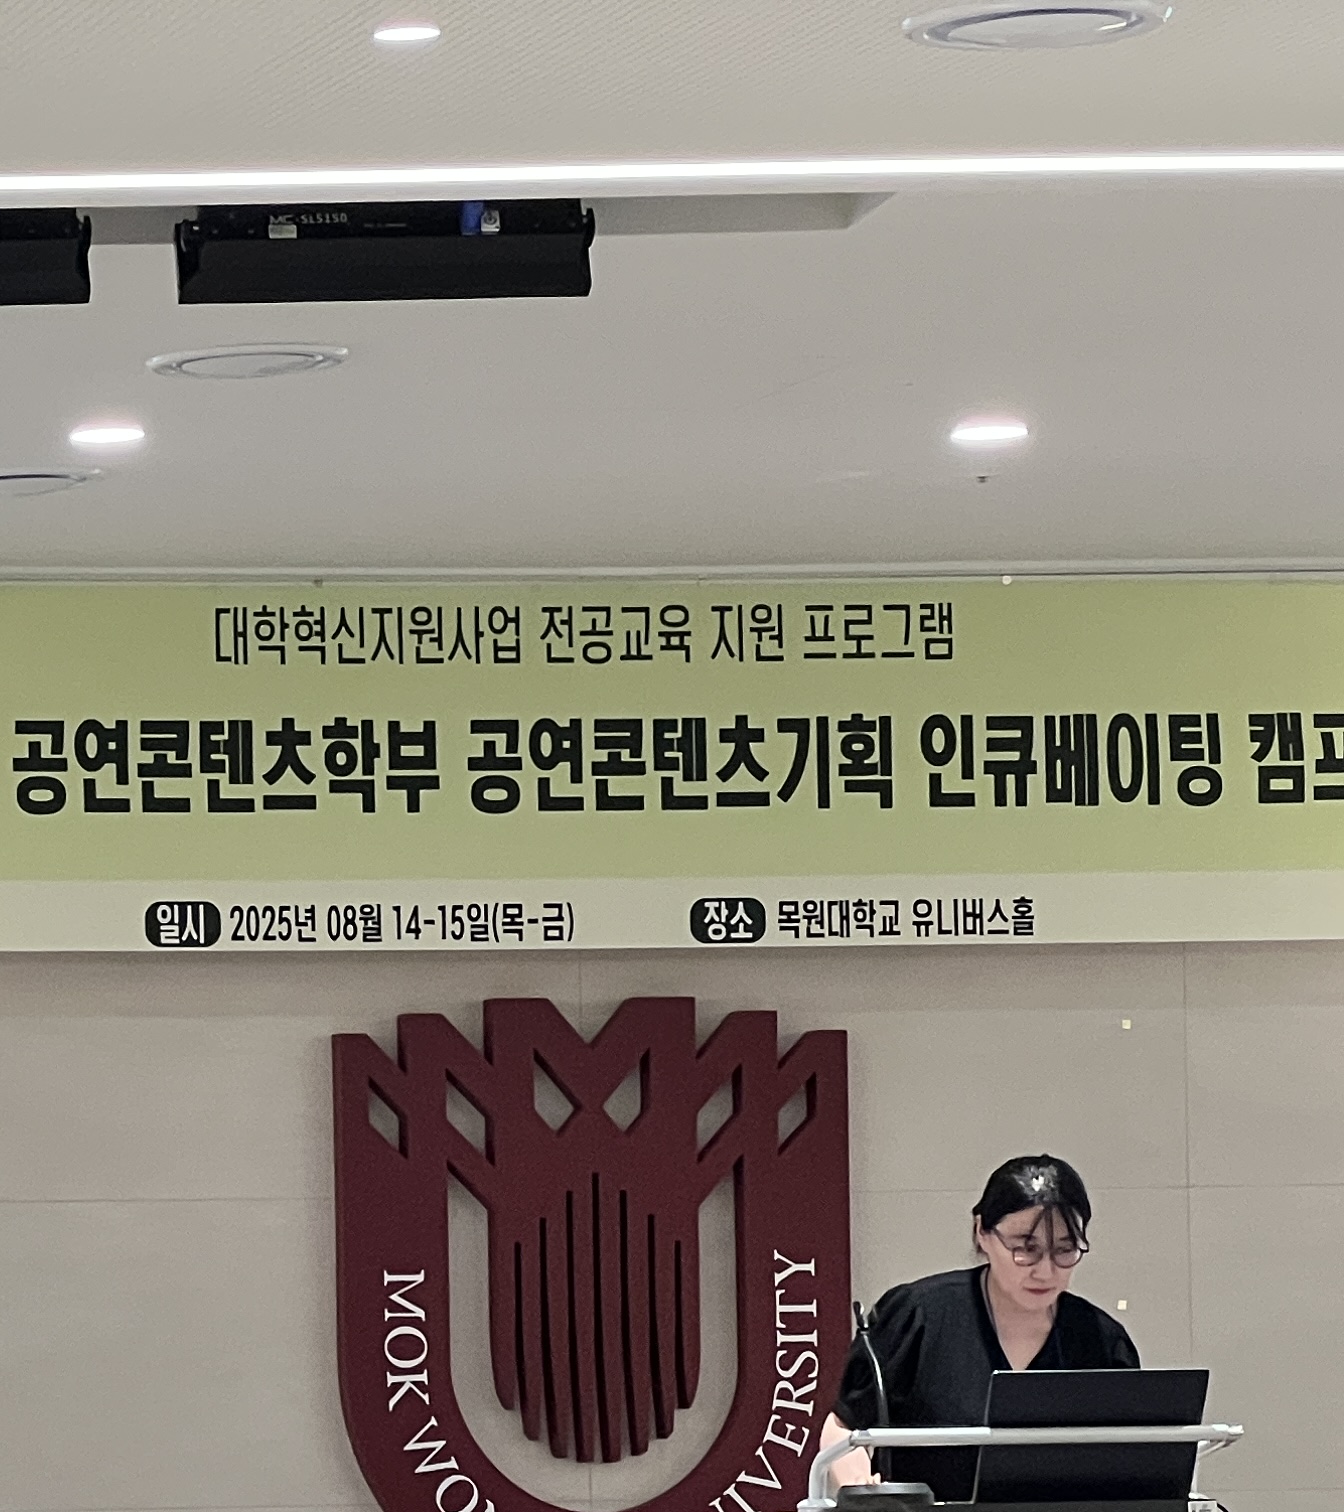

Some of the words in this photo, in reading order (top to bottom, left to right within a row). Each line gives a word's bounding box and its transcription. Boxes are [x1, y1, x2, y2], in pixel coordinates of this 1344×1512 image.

[214, 604, 521, 665] 대학혁신지원사업
[540, 604, 692, 664] 전공교육
[710, 603, 784, 663] 지원
[803, 601, 954, 661] 프로그램
[12, 717, 440, 816] 공연콘텐츠학부
[466, 711, 895, 813] 공연콘텐츠기획
[920, 711, 1223, 808] 인큐베이팅
[156, 903, 205, 944] 일시
[229, 904, 316, 942] 2025년
[327, 903, 382, 943] 08월
[392, 902, 574, 943] 14-15일(목-금)
[703, 900, 754, 941] 장소
[778, 898, 901, 939] 목원대학교
[912, 896, 1034, 937] 유니버스홀
[383, 1269, 430, 1412] MOK
